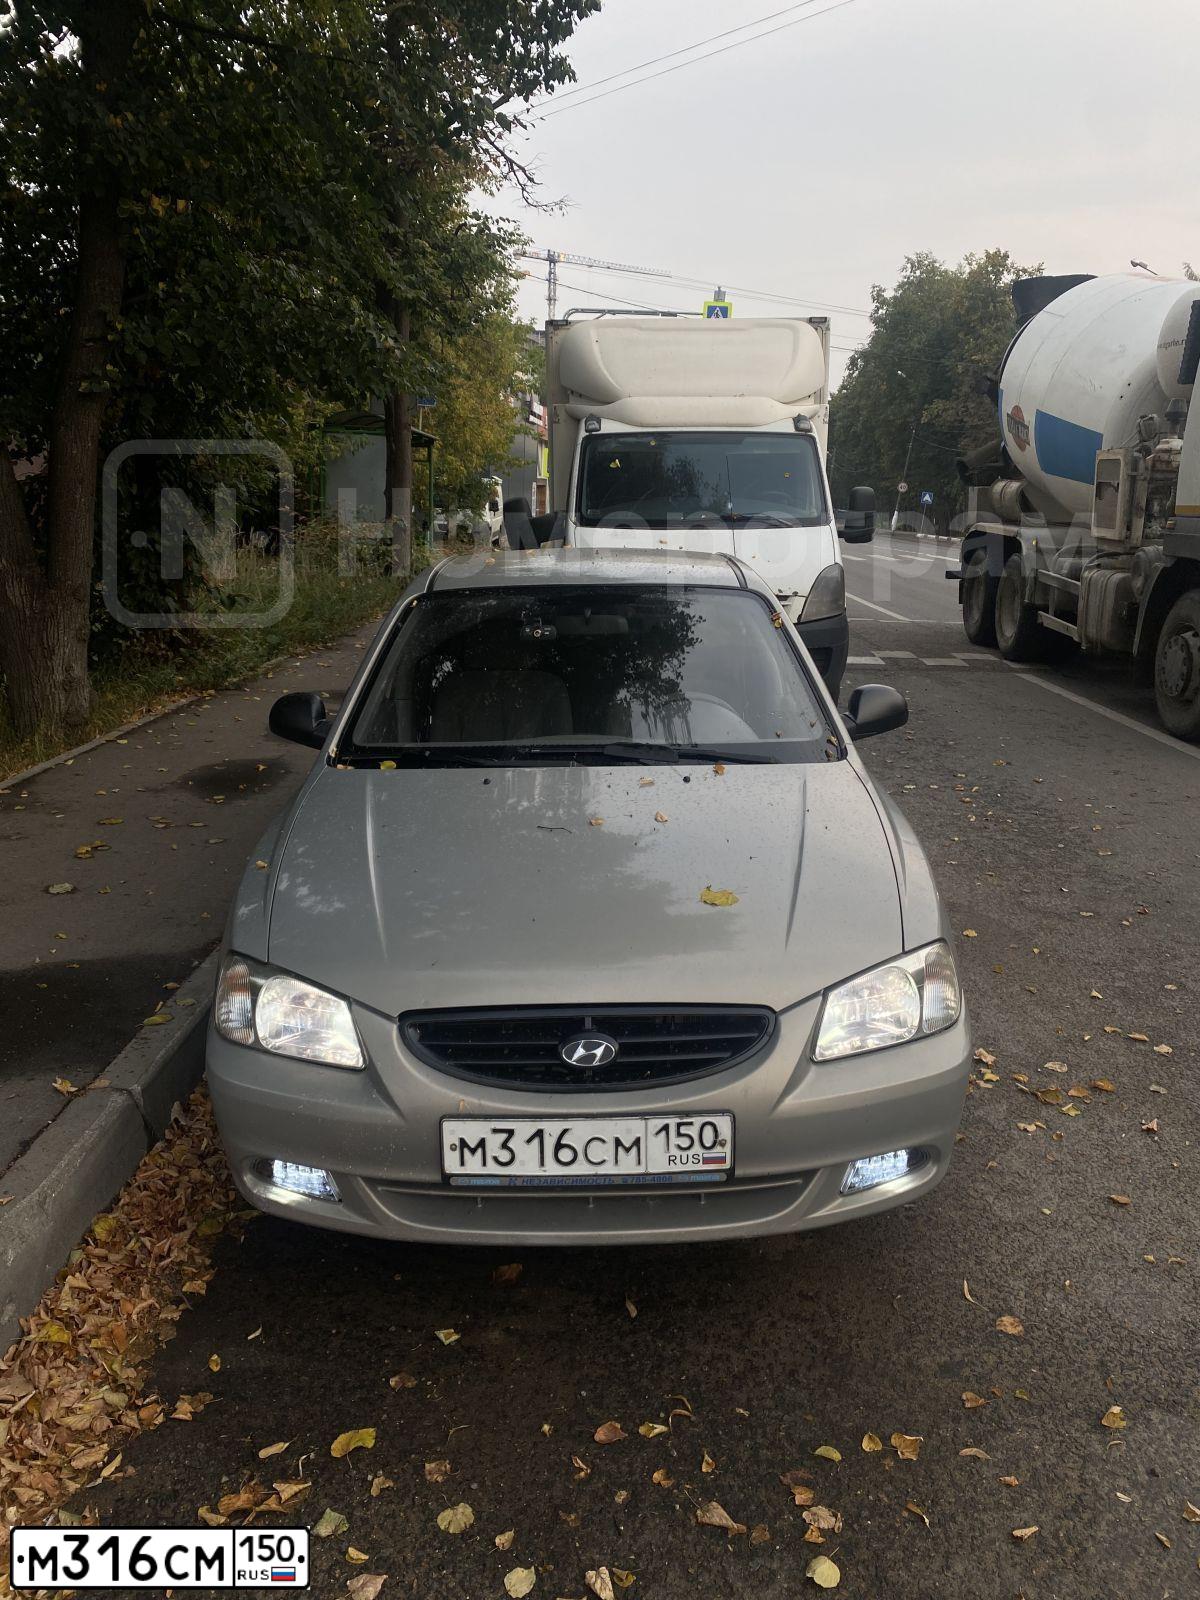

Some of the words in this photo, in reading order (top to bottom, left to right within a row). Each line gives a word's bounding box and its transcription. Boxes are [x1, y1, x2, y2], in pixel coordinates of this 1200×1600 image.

[458, 1127, 642, 1168] М316СМ
[654, 1120, 721, 1153] 150
[667, 1153, 701, 1166] RUS
